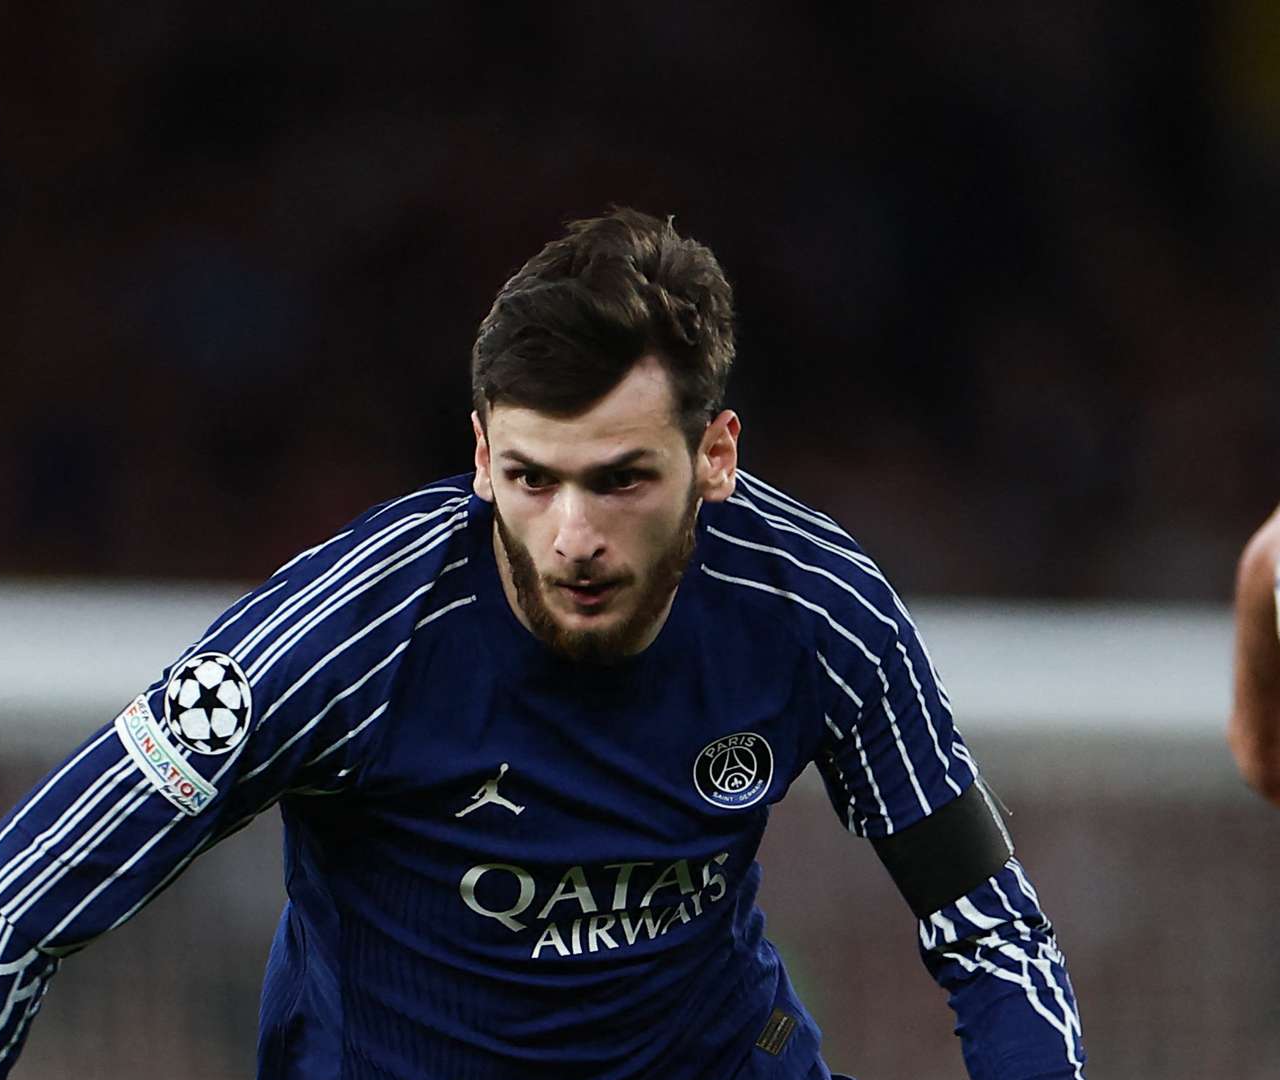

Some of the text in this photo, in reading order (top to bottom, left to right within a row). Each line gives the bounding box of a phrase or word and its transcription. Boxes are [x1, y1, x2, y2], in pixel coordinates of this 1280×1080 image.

[127, 706, 208, 807] FOUNDATION
[705, 736, 757, 759] PARIS
[531, 874, 727, 959] AIRWAYS
